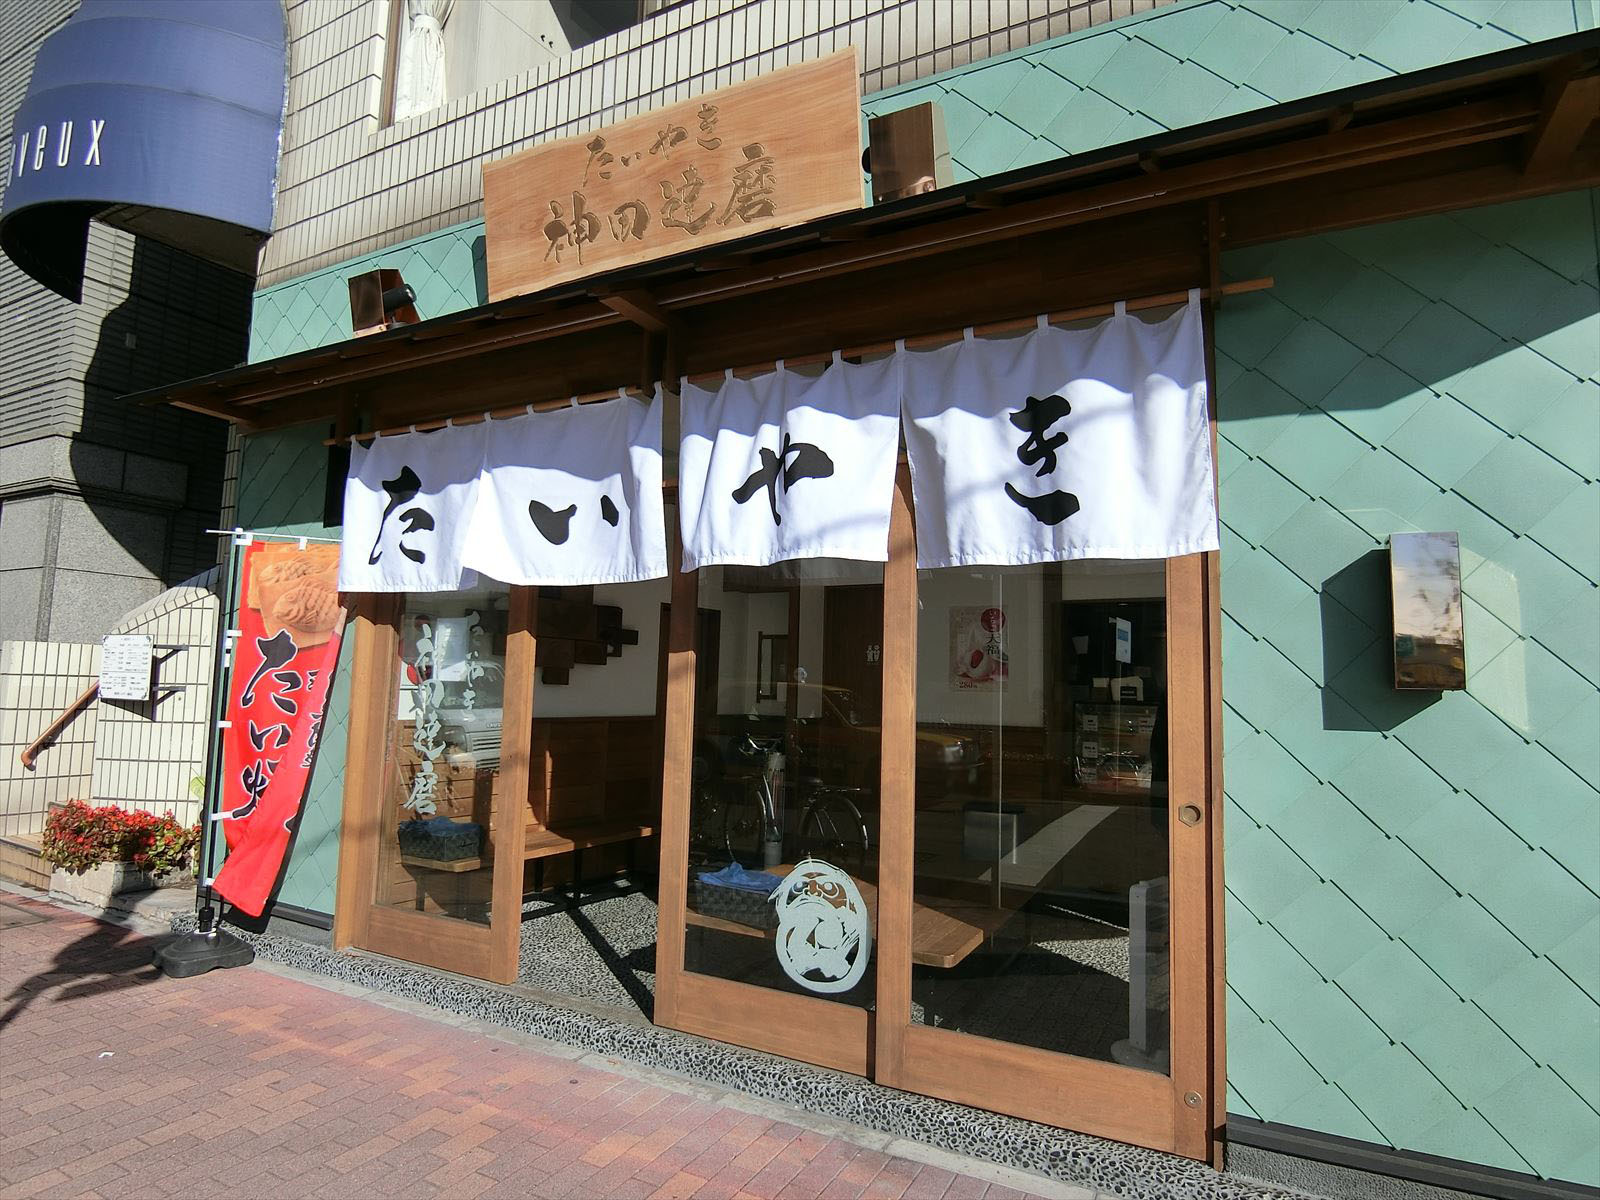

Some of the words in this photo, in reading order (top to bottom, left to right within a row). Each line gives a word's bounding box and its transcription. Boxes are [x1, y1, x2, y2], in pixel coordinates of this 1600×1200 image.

[582, 103, 722, 188] たいやき
[543, 142, 777, 266] 神田達磨
